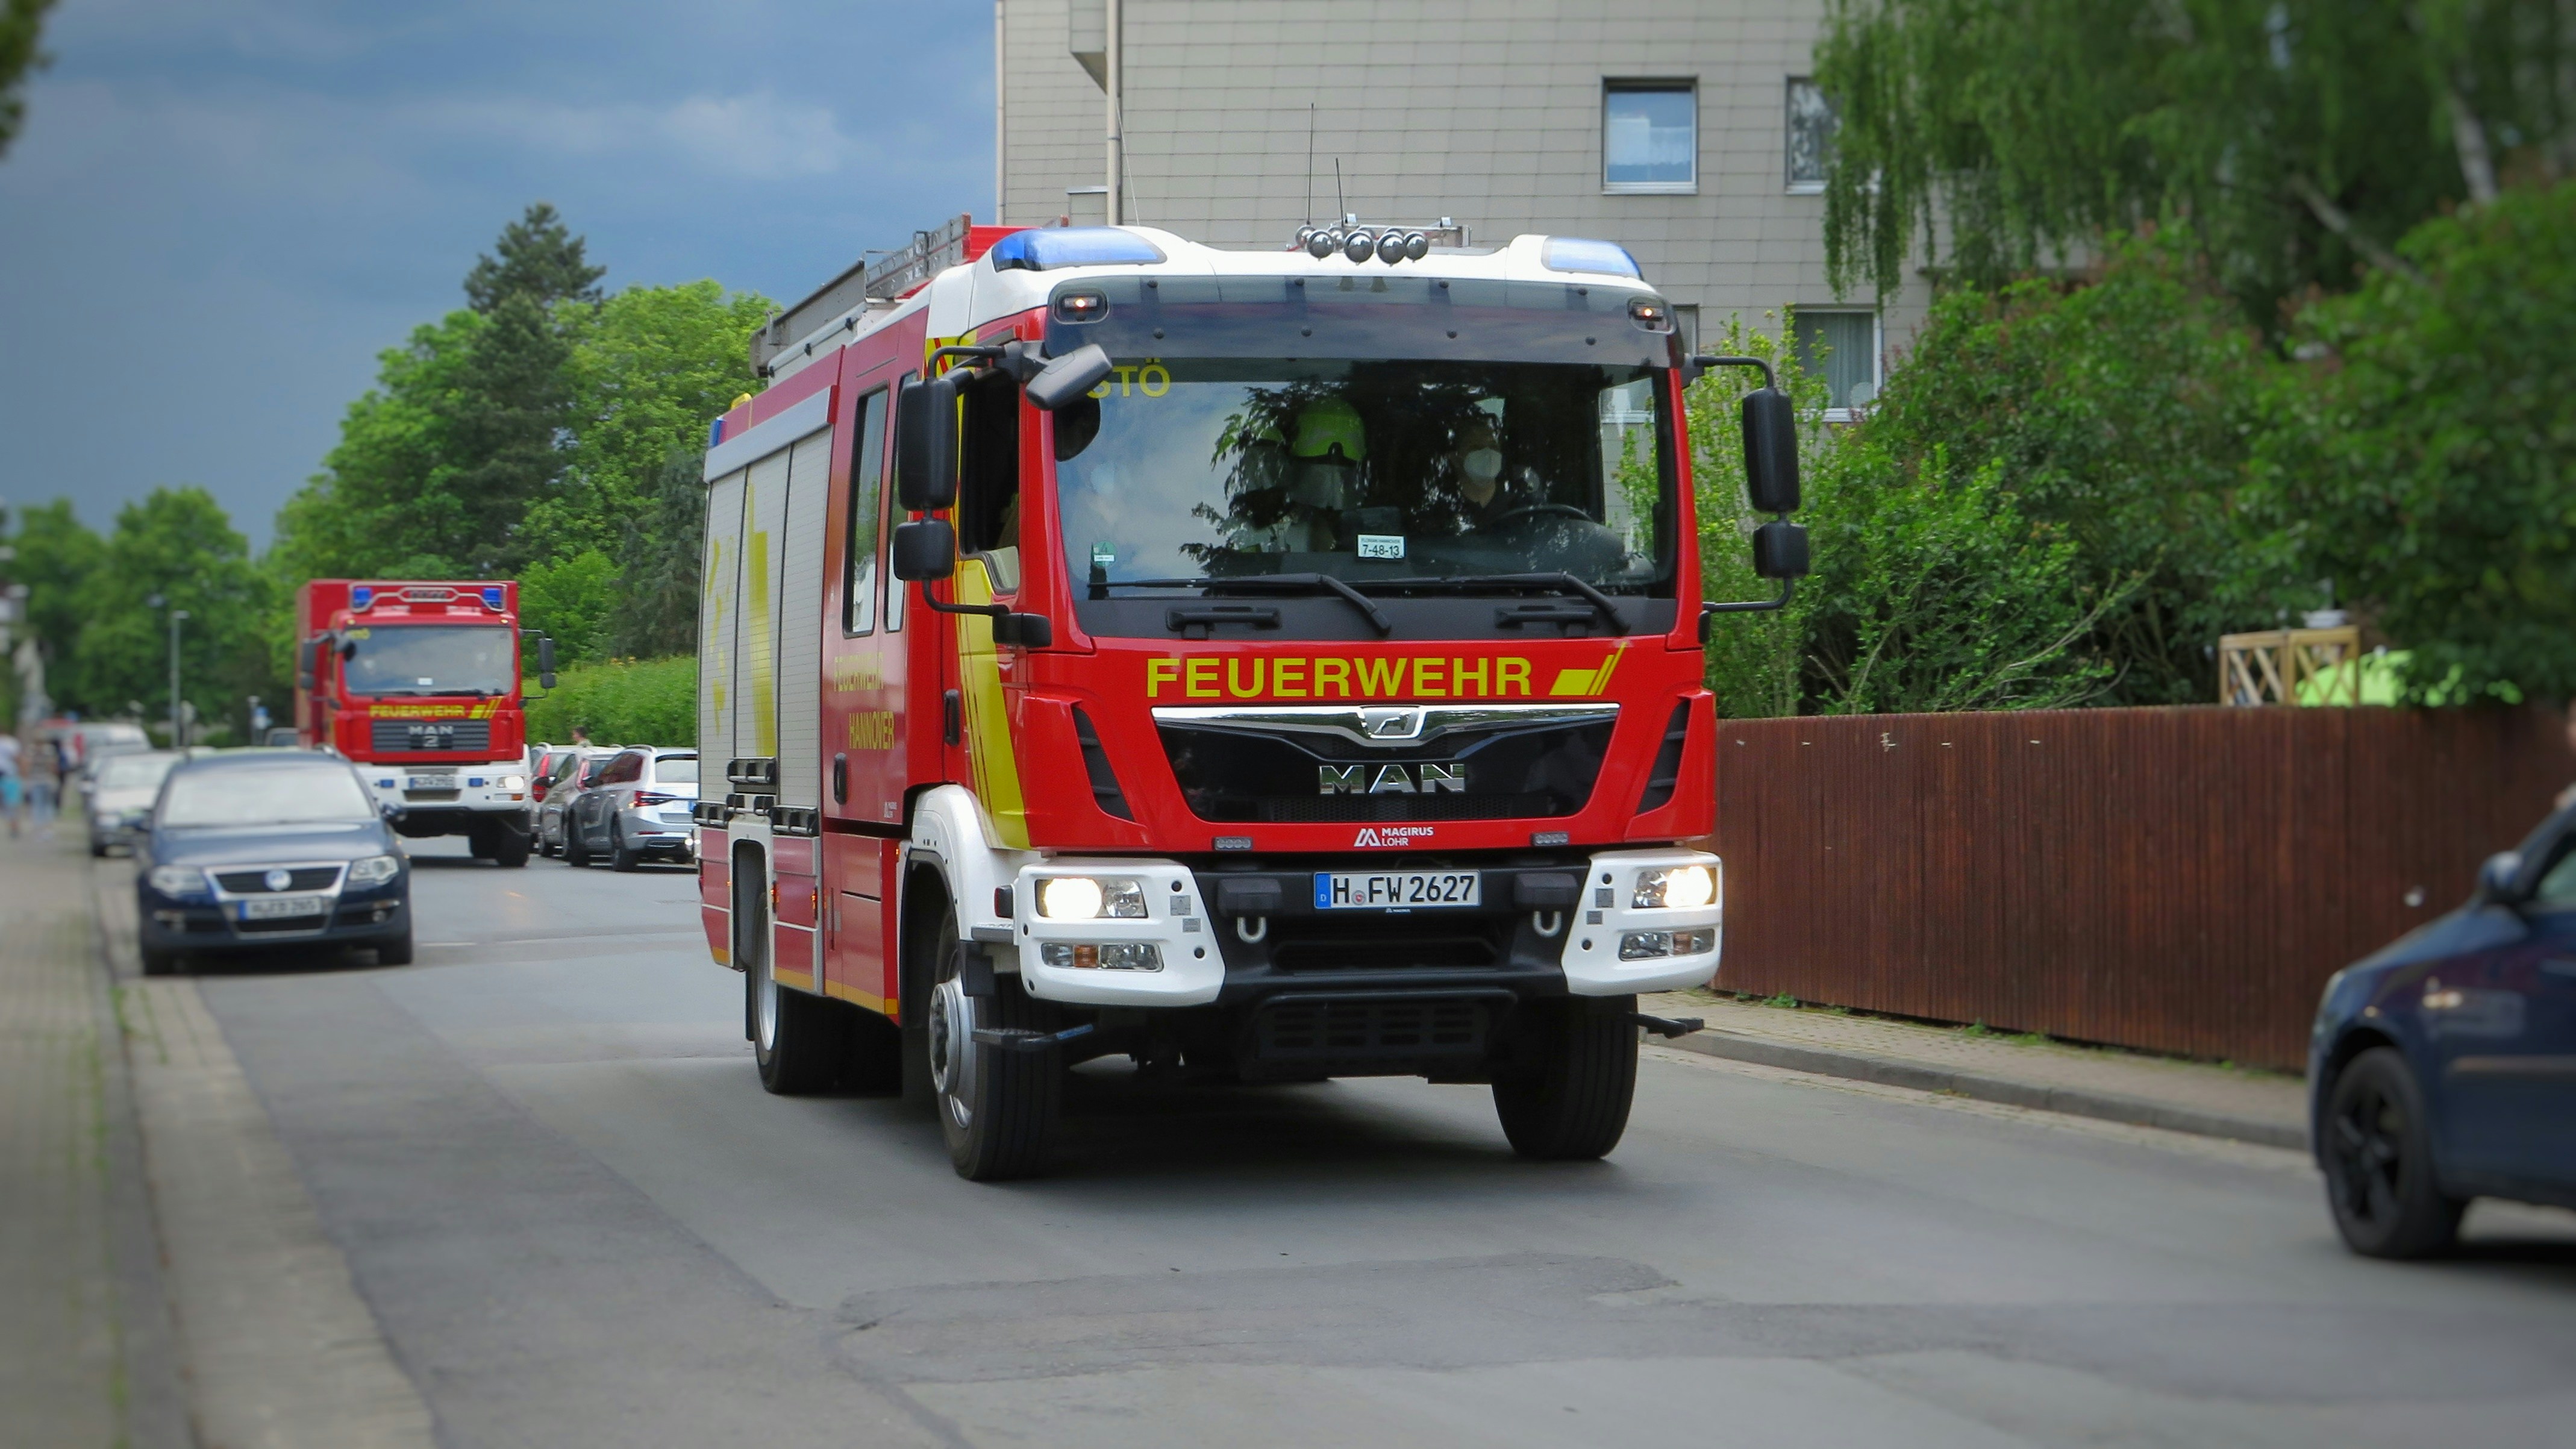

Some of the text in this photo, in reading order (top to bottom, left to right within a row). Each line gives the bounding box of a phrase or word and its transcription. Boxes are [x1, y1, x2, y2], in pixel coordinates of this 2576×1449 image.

[1363, 544, 1399, 556] 7-48-13
[834, 652, 884, 692] FEUERWEHR
[1147, 657, 1531, 698] FEUERWEHR
[370, 705, 466, 718] FEUERWEHR
[408, 726, 454, 735] MAN
[849, 711, 895, 750] HANNOVER
[1319, 764, 1465, 794] MAN
[1381, 827, 1434, 836] MAGIRUS
[1381, 837, 1408, 847] LOHR
[1333, 875, 1474, 903] H FW 2627
[1320, 893, 1327, 902] D
